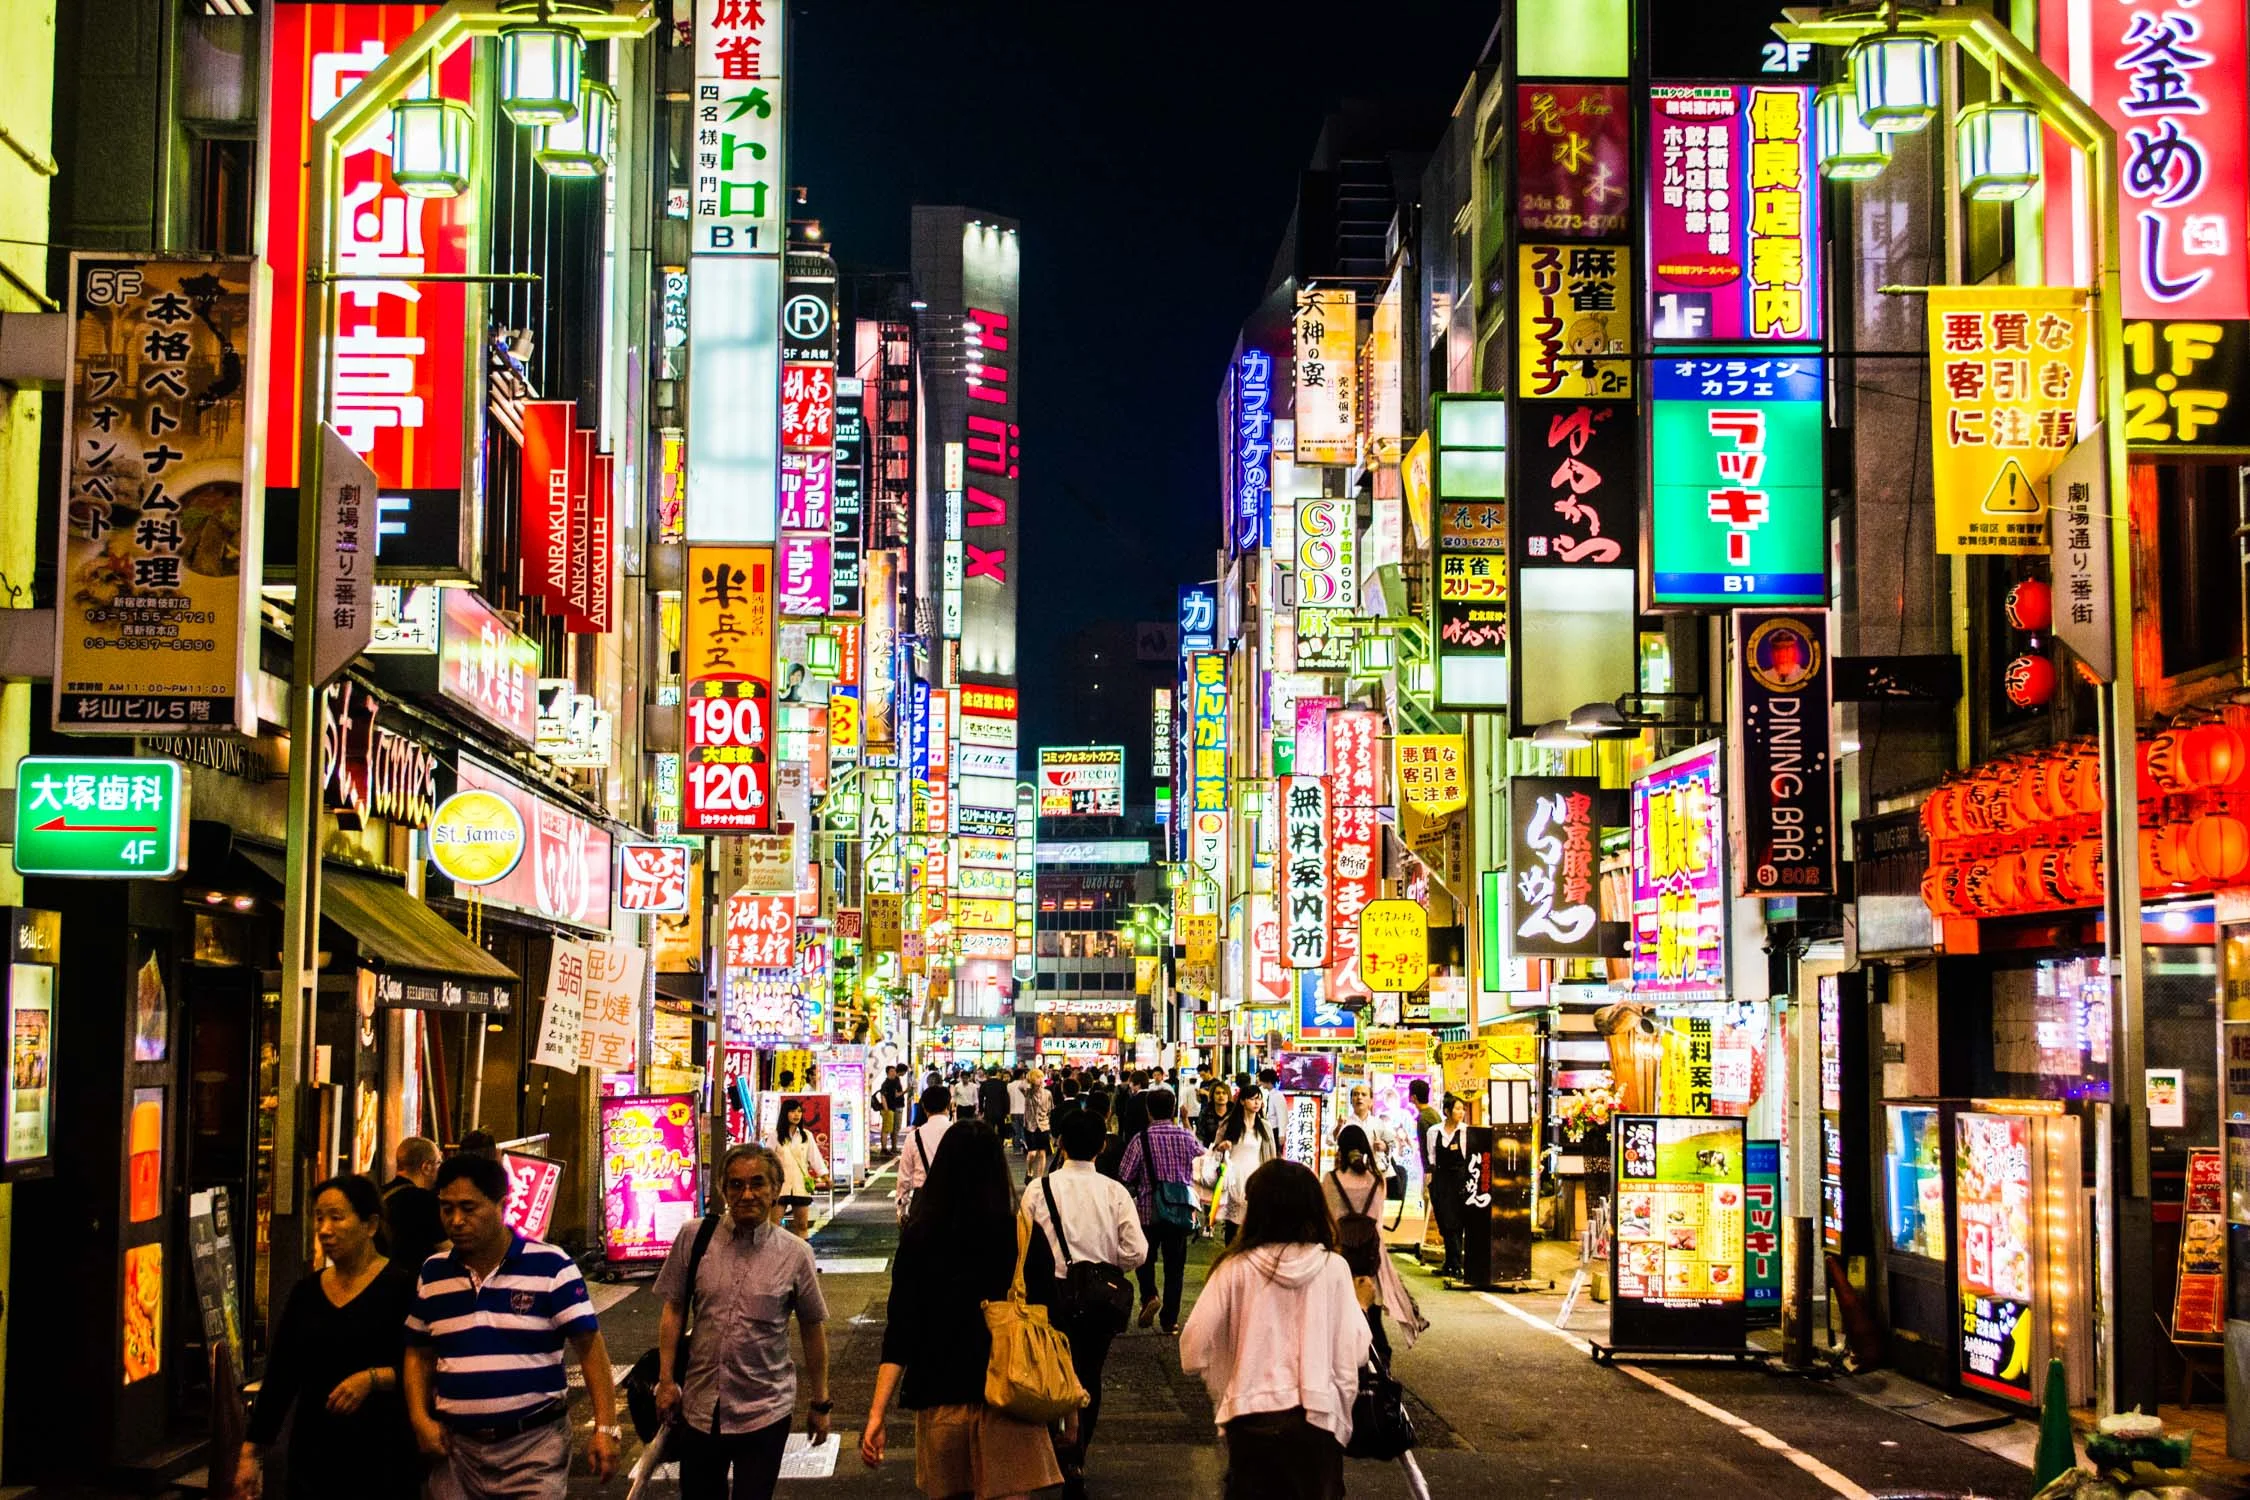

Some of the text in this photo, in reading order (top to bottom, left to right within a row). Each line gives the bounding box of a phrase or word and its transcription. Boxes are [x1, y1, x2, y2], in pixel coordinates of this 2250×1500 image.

[711, 0, 766, 80] 麻雀
[1761, 43, 1811, 73] 2F
[1666, 101, 1735, 115] 無料案内所
[698, 86, 719, 217] 四名様専門店
[1663, 126, 1684, 208] ホテル可
[2119, 15, 2206, 298] 釜めし
[710, 226, 758, 248] B1
[1751, 91, 1804, 333] 優良店案内
[87, 268, 143, 306] 5F
[1567, 249, 1617, 312] 麻雀
[1530, 246, 1568, 395] スリーファイブ
[1659, 294, 1706, 336] 1F
[1945, 313, 2072, 352] 悪質な
[1601, 370, 1628, 392] 2F
[1674, 361, 1801, 378] オンライン
[1701, 380, 1774, 396] カフェ
[1946, 361, 2071, 401] 客引き
[133, 292, 193, 589] 本格ベトナム料理
[1949, 409, 2076, 449] に注意
[2123, 388, 2228, 441] 2F
[804, 455, 826, 528] レンタル
[1708, 409, 1769, 566] ラッキー
[547, 469, 567, 590] ANRAKUTEI
[569, 493, 587, 609] ANRAKUTEI
[1299, 500, 1337, 604] GOD
[2067, 482, 2094, 624] 劇場通り一番街
[334, 484, 362, 630] 劇場通り一番街
[1723, 576, 1756, 592] B1
[1402, 747, 1456, 762] 悪質な
[1403, 767, 1457, 783] 客引き
[1768, 698, 1804, 799] DINING
[30, 773, 163, 812] 大塚歯科
[1404, 786, 1460, 802] に注意
[120, 839, 157, 865] 4F
[463, 825, 517, 844] James
[1562, 792, 1593, 904] 東京豚骨
[1772, 806, 1805, 862] BAR
[1291, 785, 1324, 959] 無料案内所
